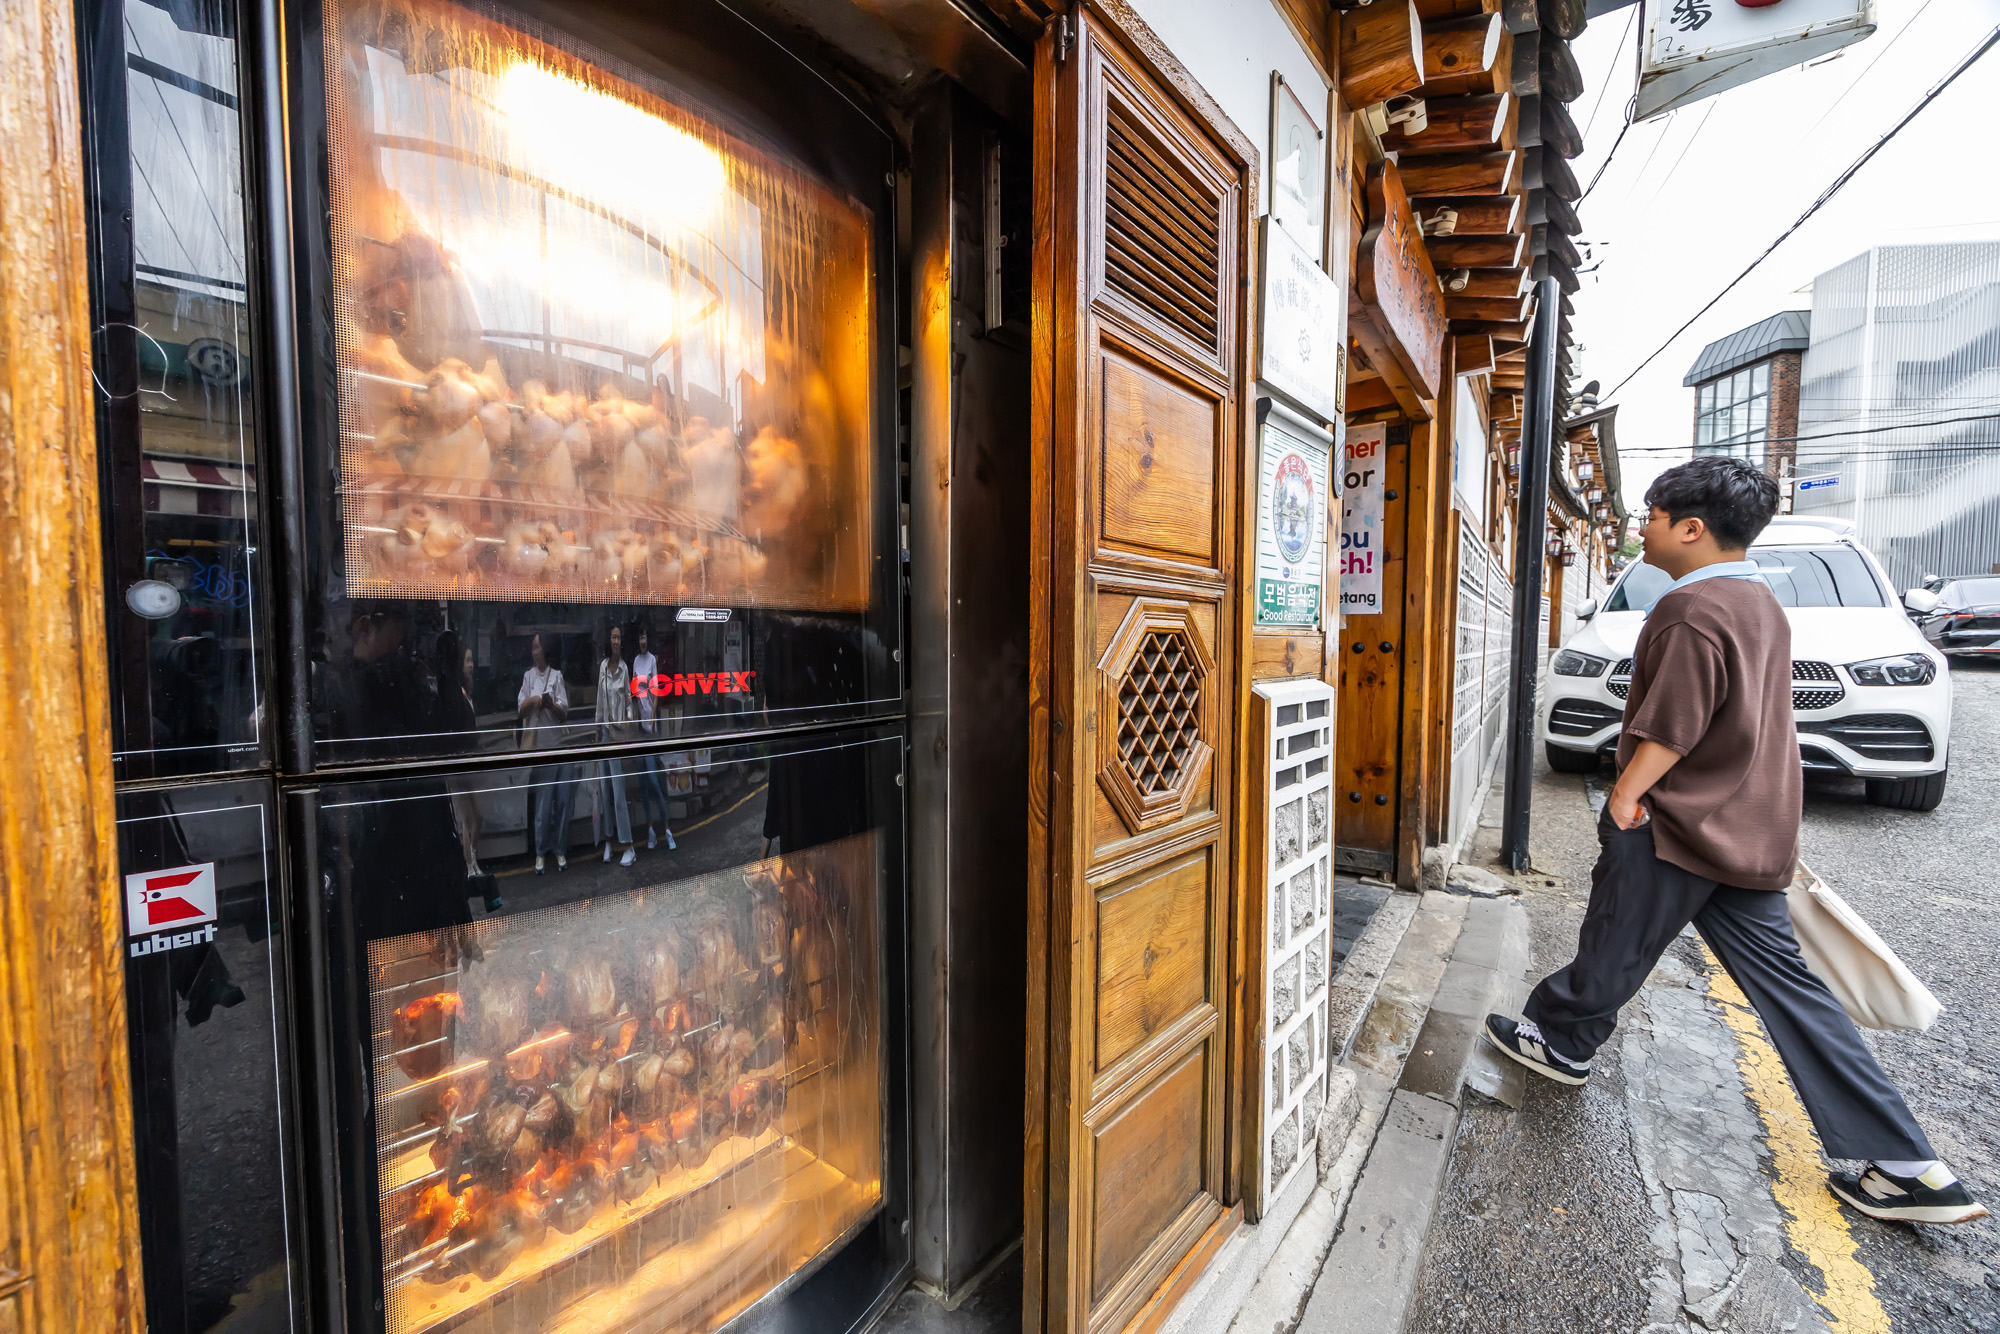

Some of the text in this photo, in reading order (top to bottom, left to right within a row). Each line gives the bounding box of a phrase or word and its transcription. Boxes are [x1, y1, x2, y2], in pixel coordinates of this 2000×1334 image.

[1264, 583, 1316, 608] 모범음식점
[1263, 608, 1283, 621] Good
[130, 923, 218, 958] ubert
